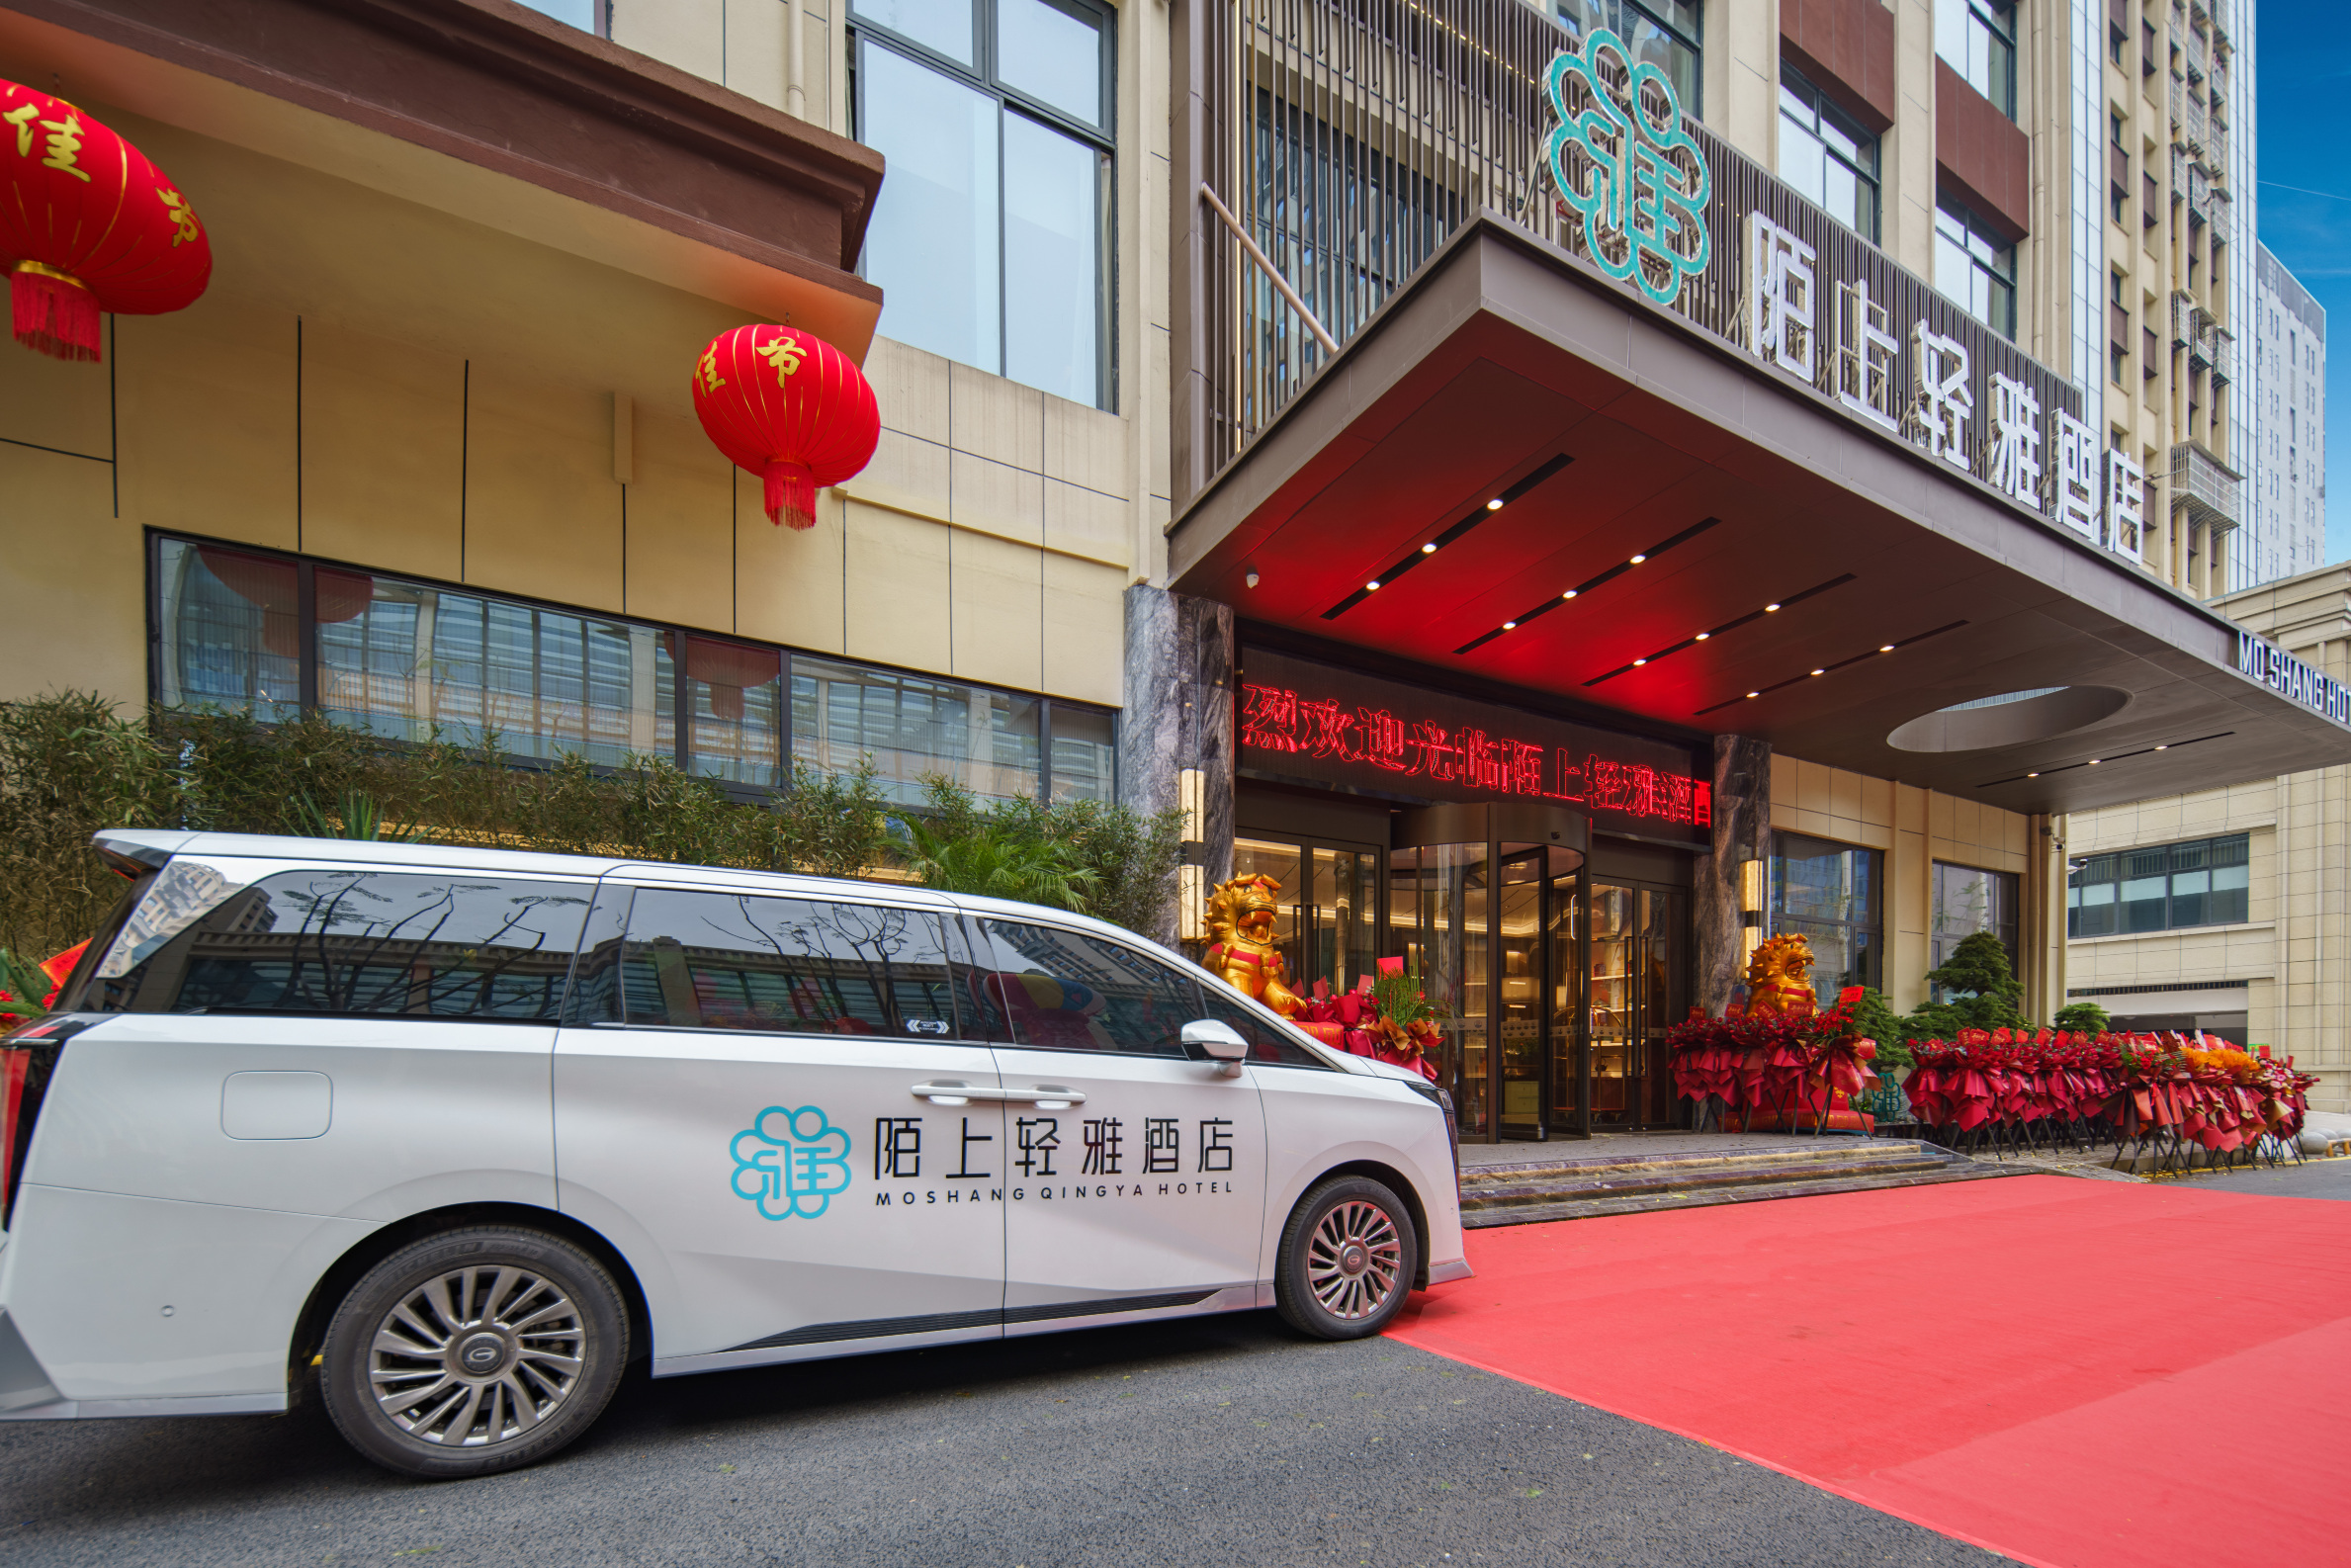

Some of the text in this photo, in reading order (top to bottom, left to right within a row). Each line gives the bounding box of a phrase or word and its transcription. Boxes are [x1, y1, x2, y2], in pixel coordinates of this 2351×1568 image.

[1745, 211, 2143, 565] 陌上轻雅酒店
[2238, 631, 2265, 681] MO
[2269, 649, 2324, 711] SHANG
[875, 1117, 1234, 1179] 陌上轻雅酒店
[876, 1180, 1232, 1206] MOSHANG QINGYA HOTEL
